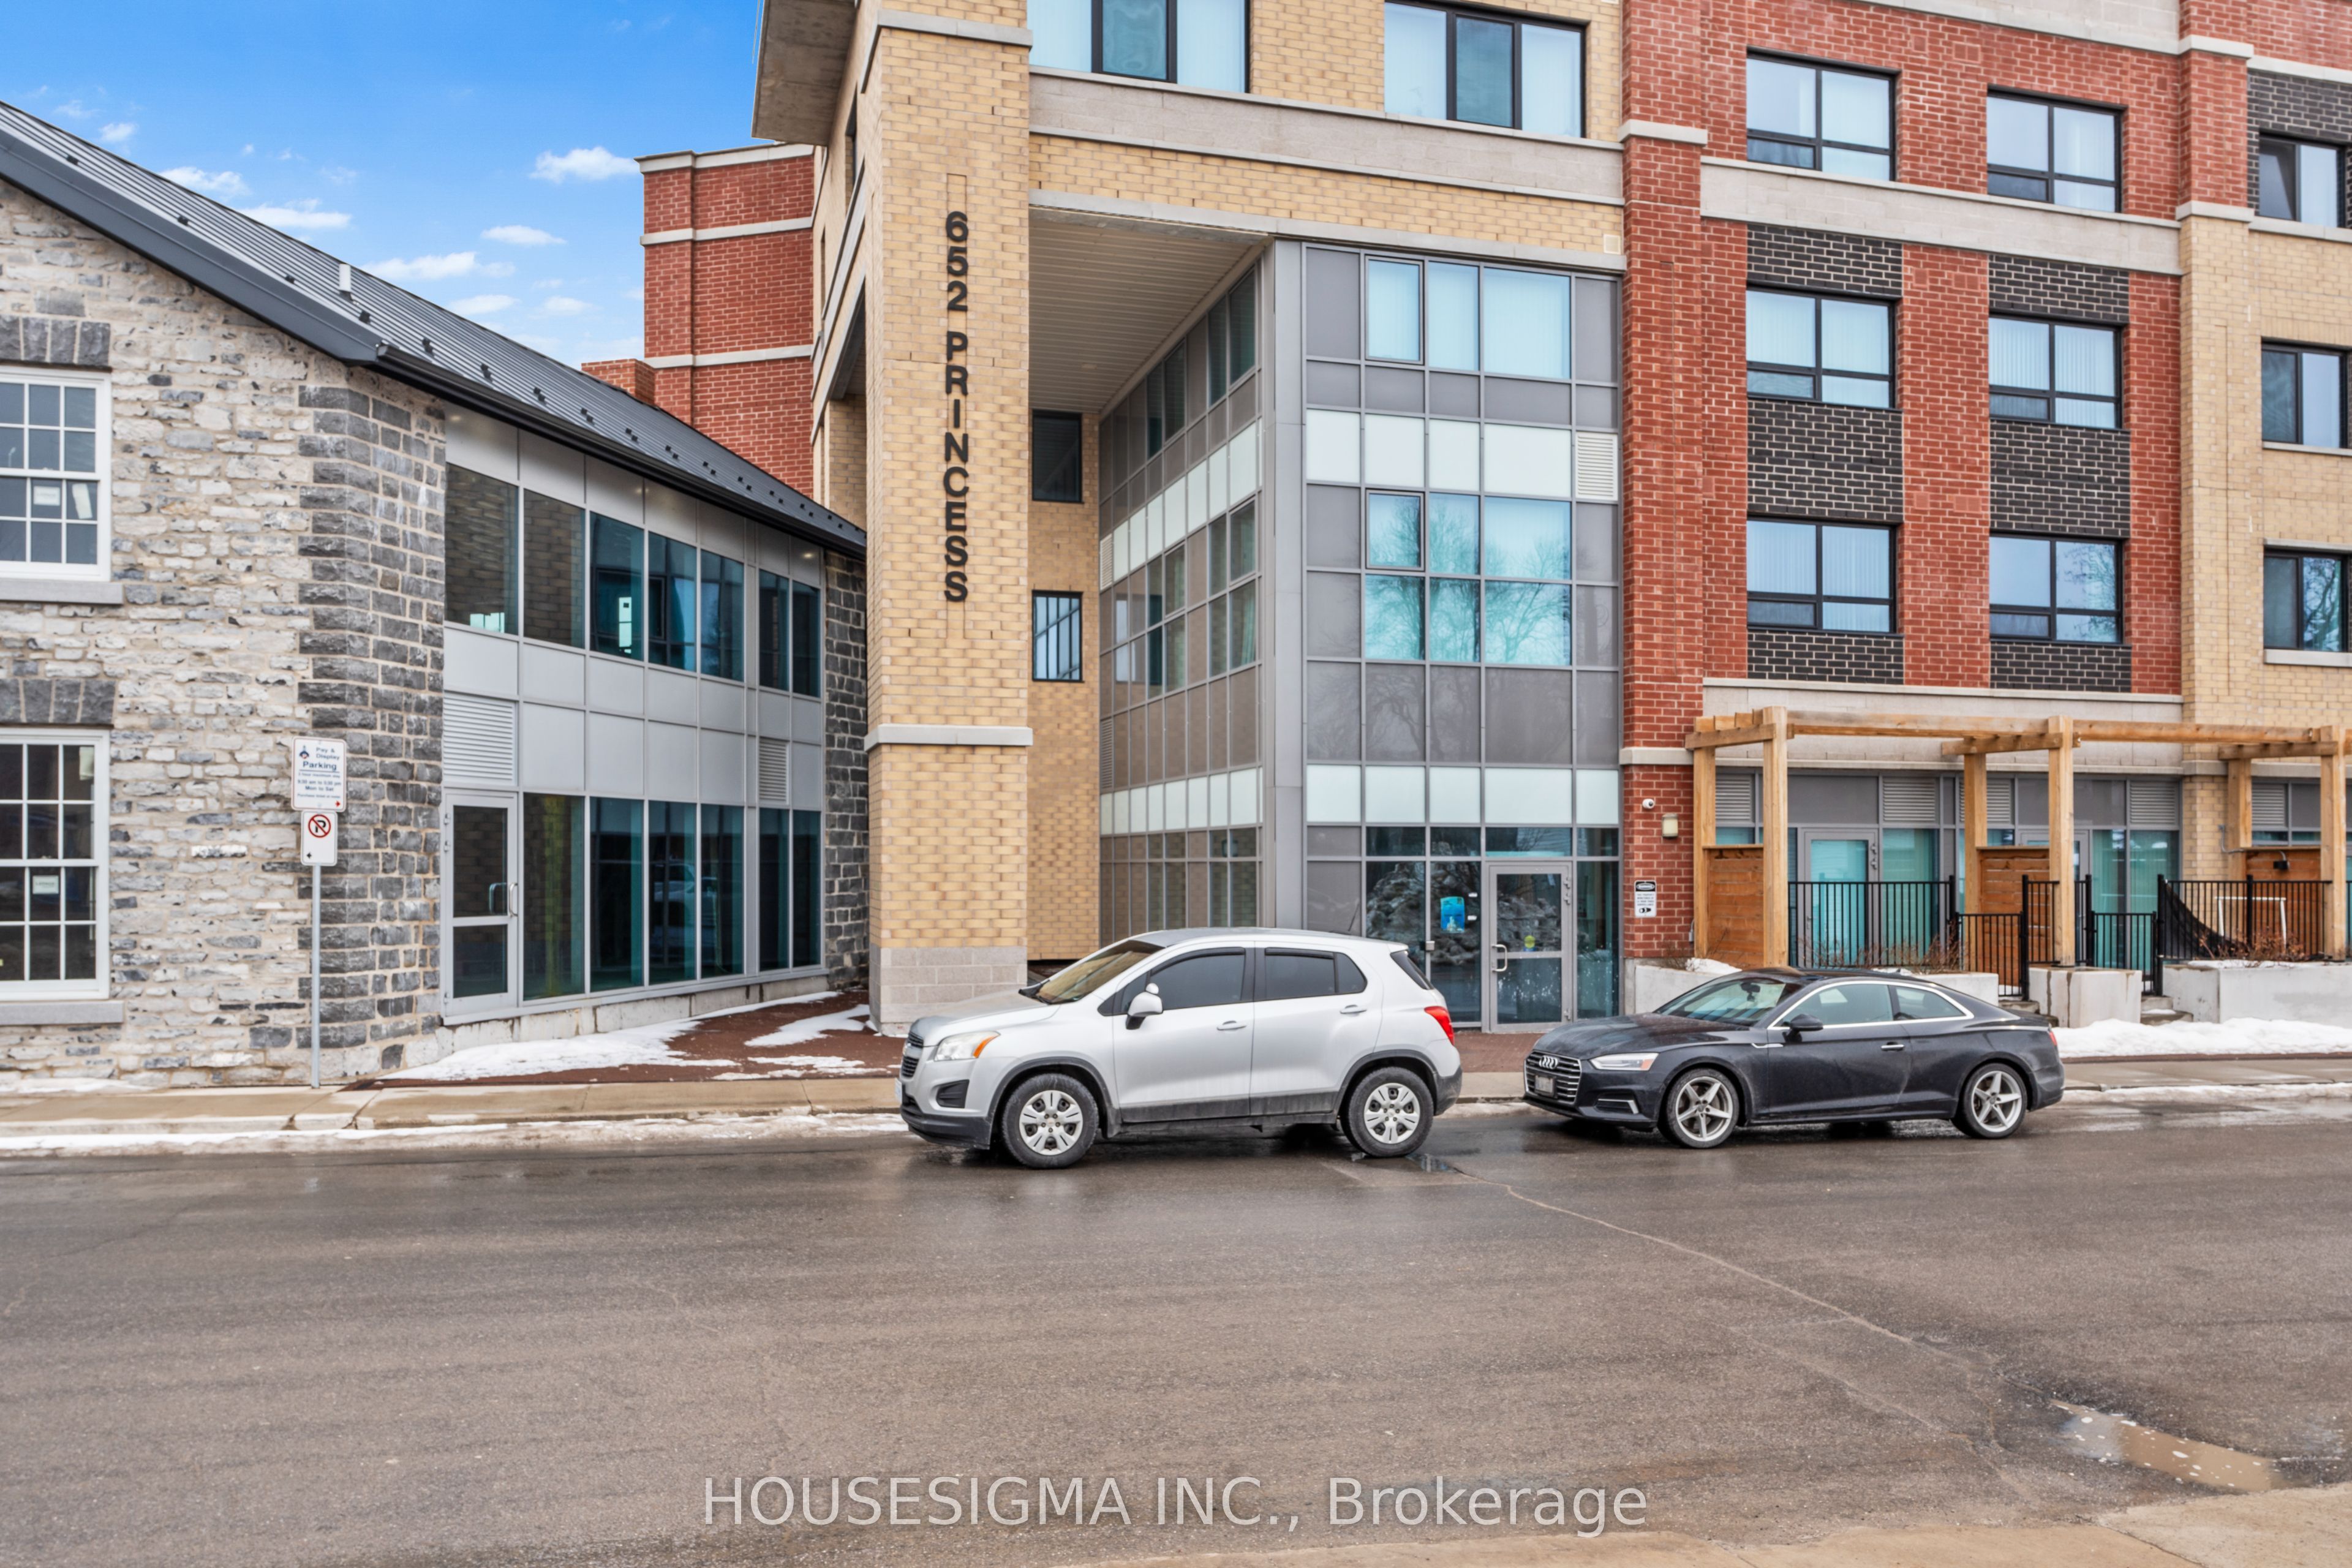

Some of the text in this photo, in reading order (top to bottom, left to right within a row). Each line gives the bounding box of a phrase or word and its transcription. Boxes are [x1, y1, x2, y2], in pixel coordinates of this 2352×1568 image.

[943, 211, 970, 603] 652 PRINCESS
[303, 761, 337, 772] Parking
